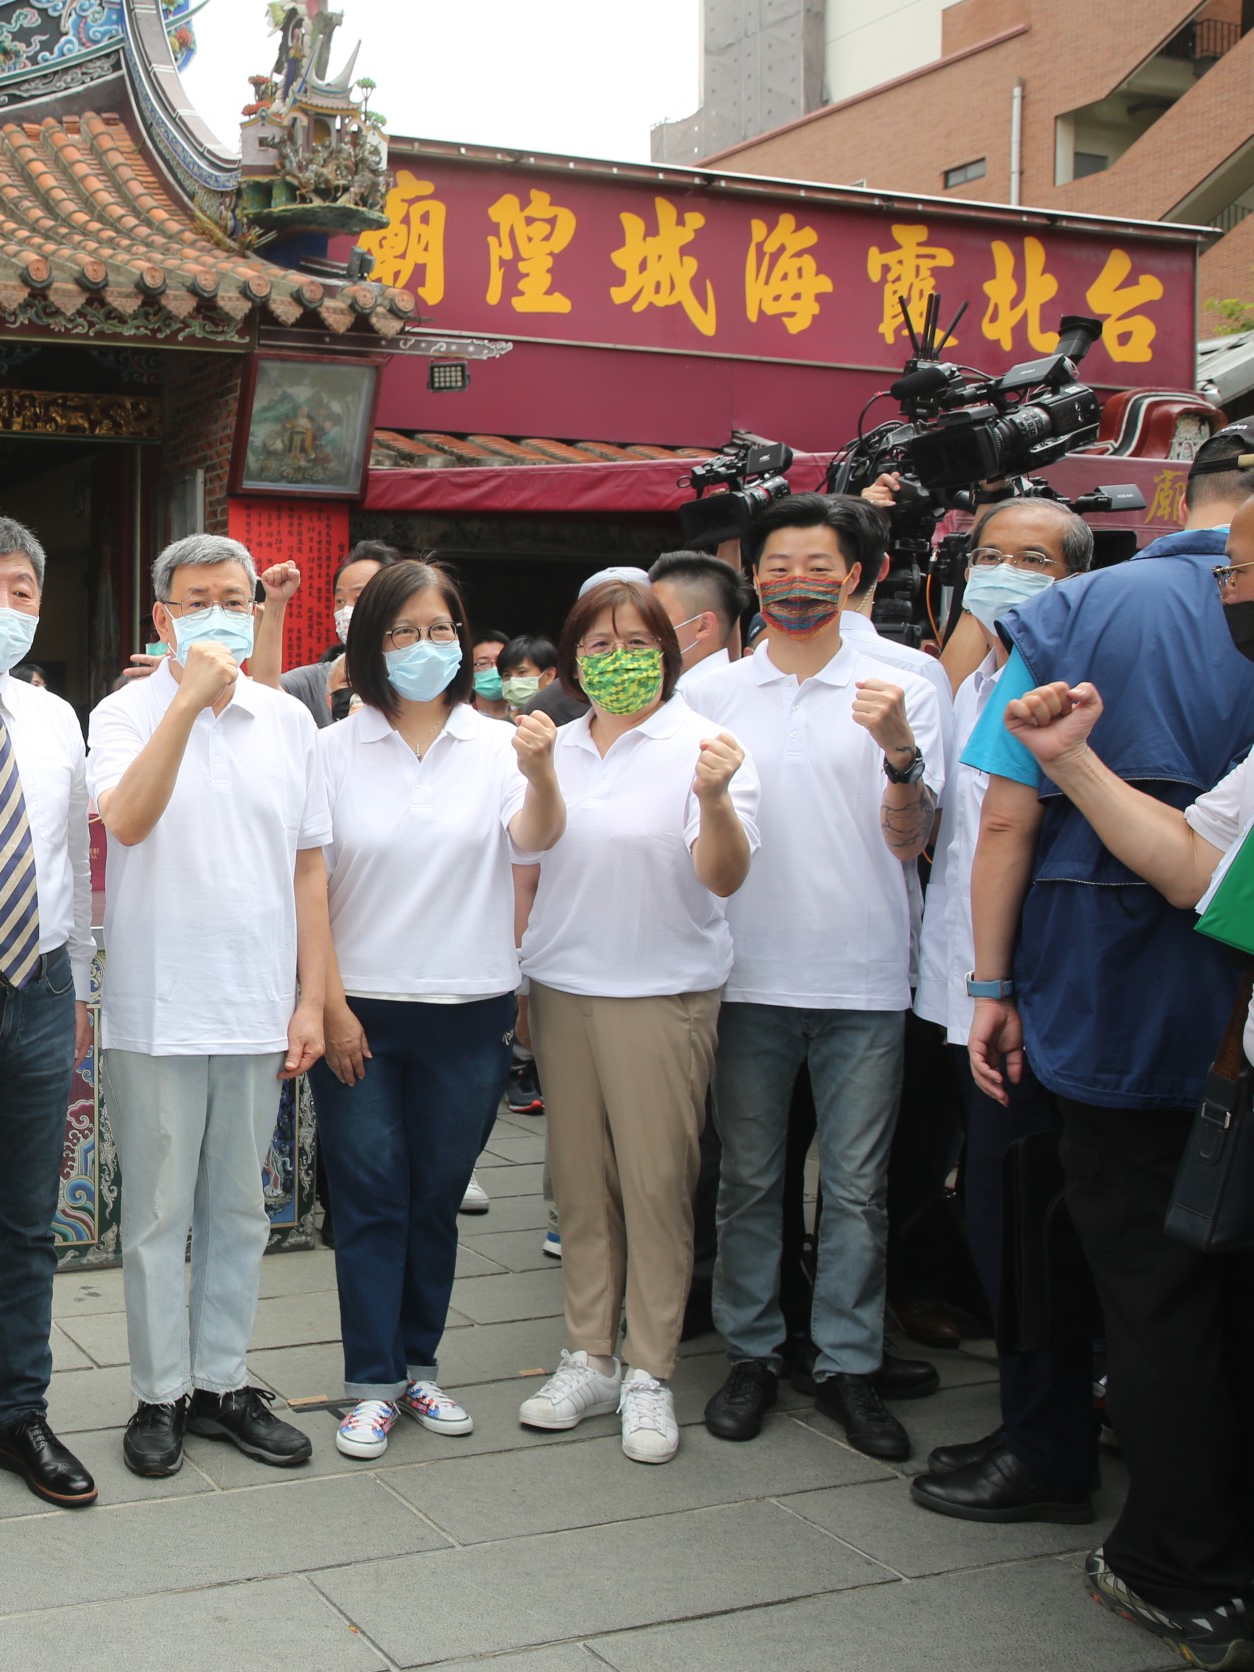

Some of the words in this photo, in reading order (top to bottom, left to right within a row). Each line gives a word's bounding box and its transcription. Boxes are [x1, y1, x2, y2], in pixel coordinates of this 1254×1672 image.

[356, 169, 1165, 363] 台北霞海城隍廟
